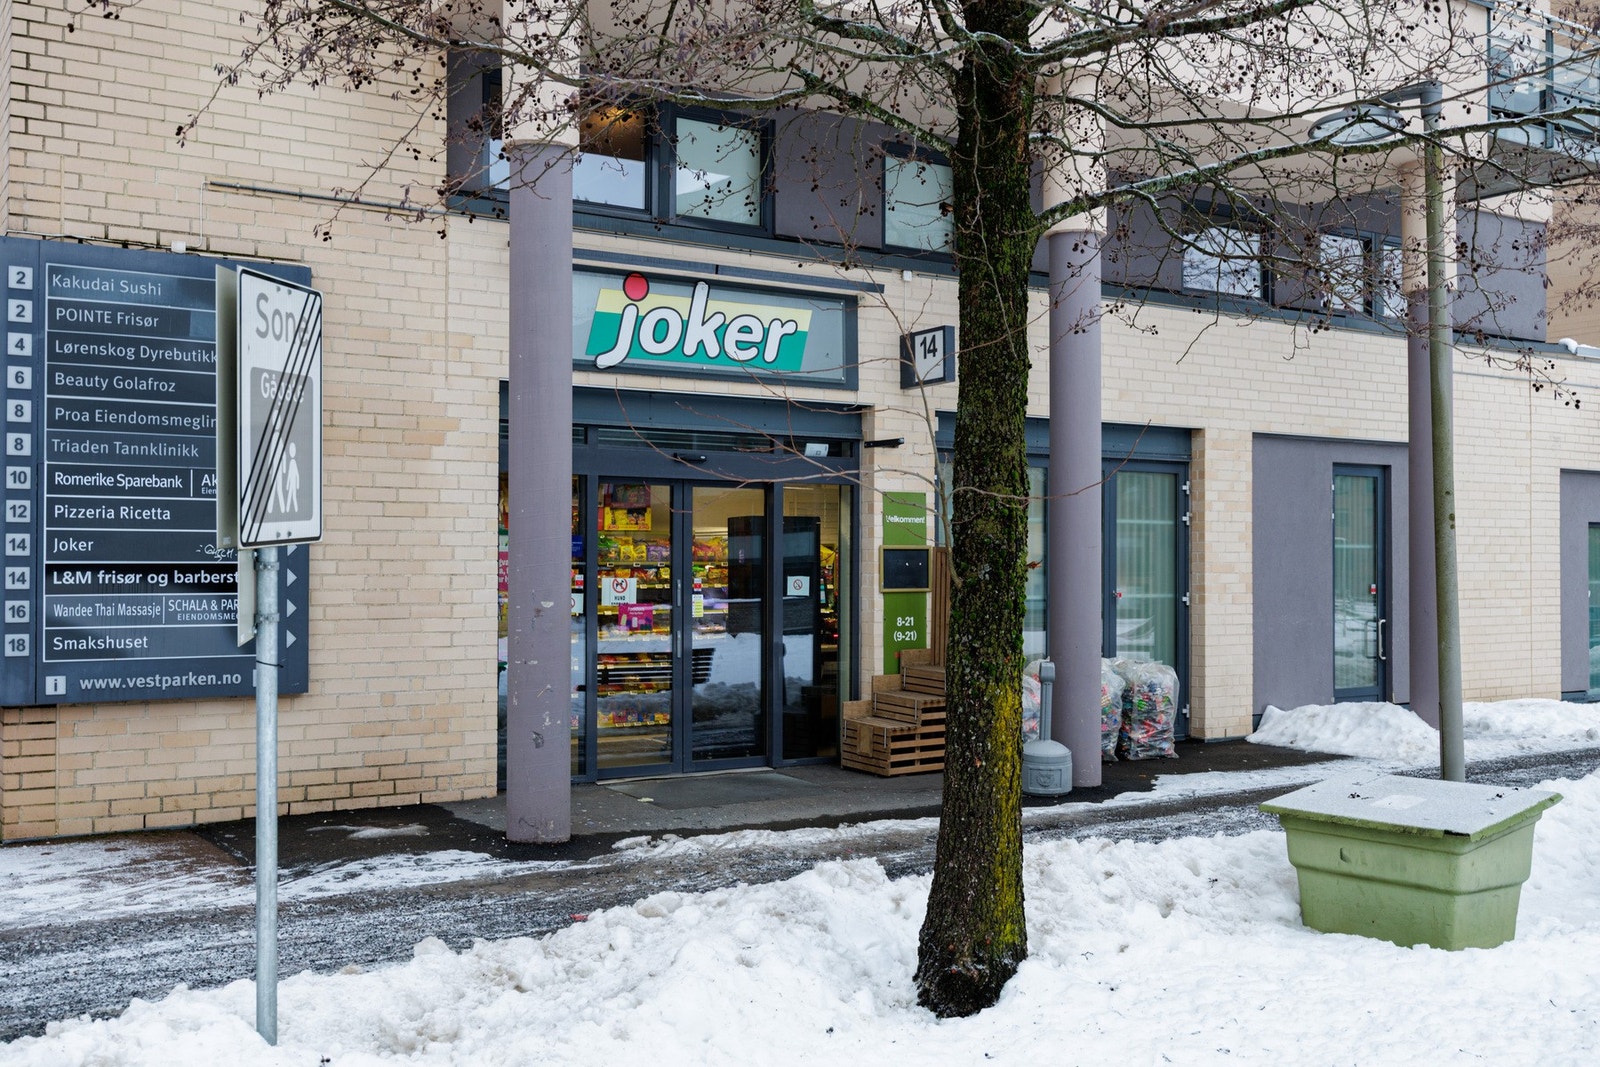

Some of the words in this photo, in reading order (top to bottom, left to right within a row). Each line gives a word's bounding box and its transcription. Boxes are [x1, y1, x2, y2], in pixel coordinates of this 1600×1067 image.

[16, 271, 26, 285] 2
[52, 273, 115, 292] Kakudai
[119, 279, 161, 296] Sushi
[15, 304, 26, 318] 2
[56, 307, 113, 325] POINTE
[117, 311, 160, 328] Frisør
[594, 272, 798, 369] joker
[14, 338, 26, 352] 4
[55, 339, 136, 361] Lørenskog
[919, 334, 938, 360] 14
[14, 371, 25, 385] 6
[55, 372, 109, 391] Beauty
[113, 375, 176, 393] Golafroz
[14, 404, 25, 418] 8
[55, 407, 90, 422] Proa
[13, 437, 24, 452] 8
[51, 438, 109, 455] Triaden
[113, 441, 200, 458] Tannklinikk
[10, 470, 28, 485] 10
[55, 471, 115, 487] Romerike
[116, 473, 183, 490] Sparebank
[9, 504, 28, 518] 12
[54, 504, 115, 519] Pizzeria
[119, 505, 171, 521] Ricetta
[8, 537, 27, 552] 14
[52, 537, 95, 553] Joker
[8, 571, 27, 585] 14
[53, 571, 92, 585] L&M
[97, 569, 143, 585] frisør
[147, 573, 168, 588] og
[8, 604, 27, 619] 16
[53, 603, 93, 618] Wandee
[94, 602, 116, 616] Thai
[117, 602, 161, 619] Massasje
[168, 598, 209, 612] SCHALA
[210, 599, 219, 612] &
[896, 616, 915, 627] 8-21
[52, 635, 149, 651] Smakshuset
[893, 630, 918, 642] (9-21)
[8, 638, 26, 652] 18
[79, 671, 242, 691] www.vestparken.no
